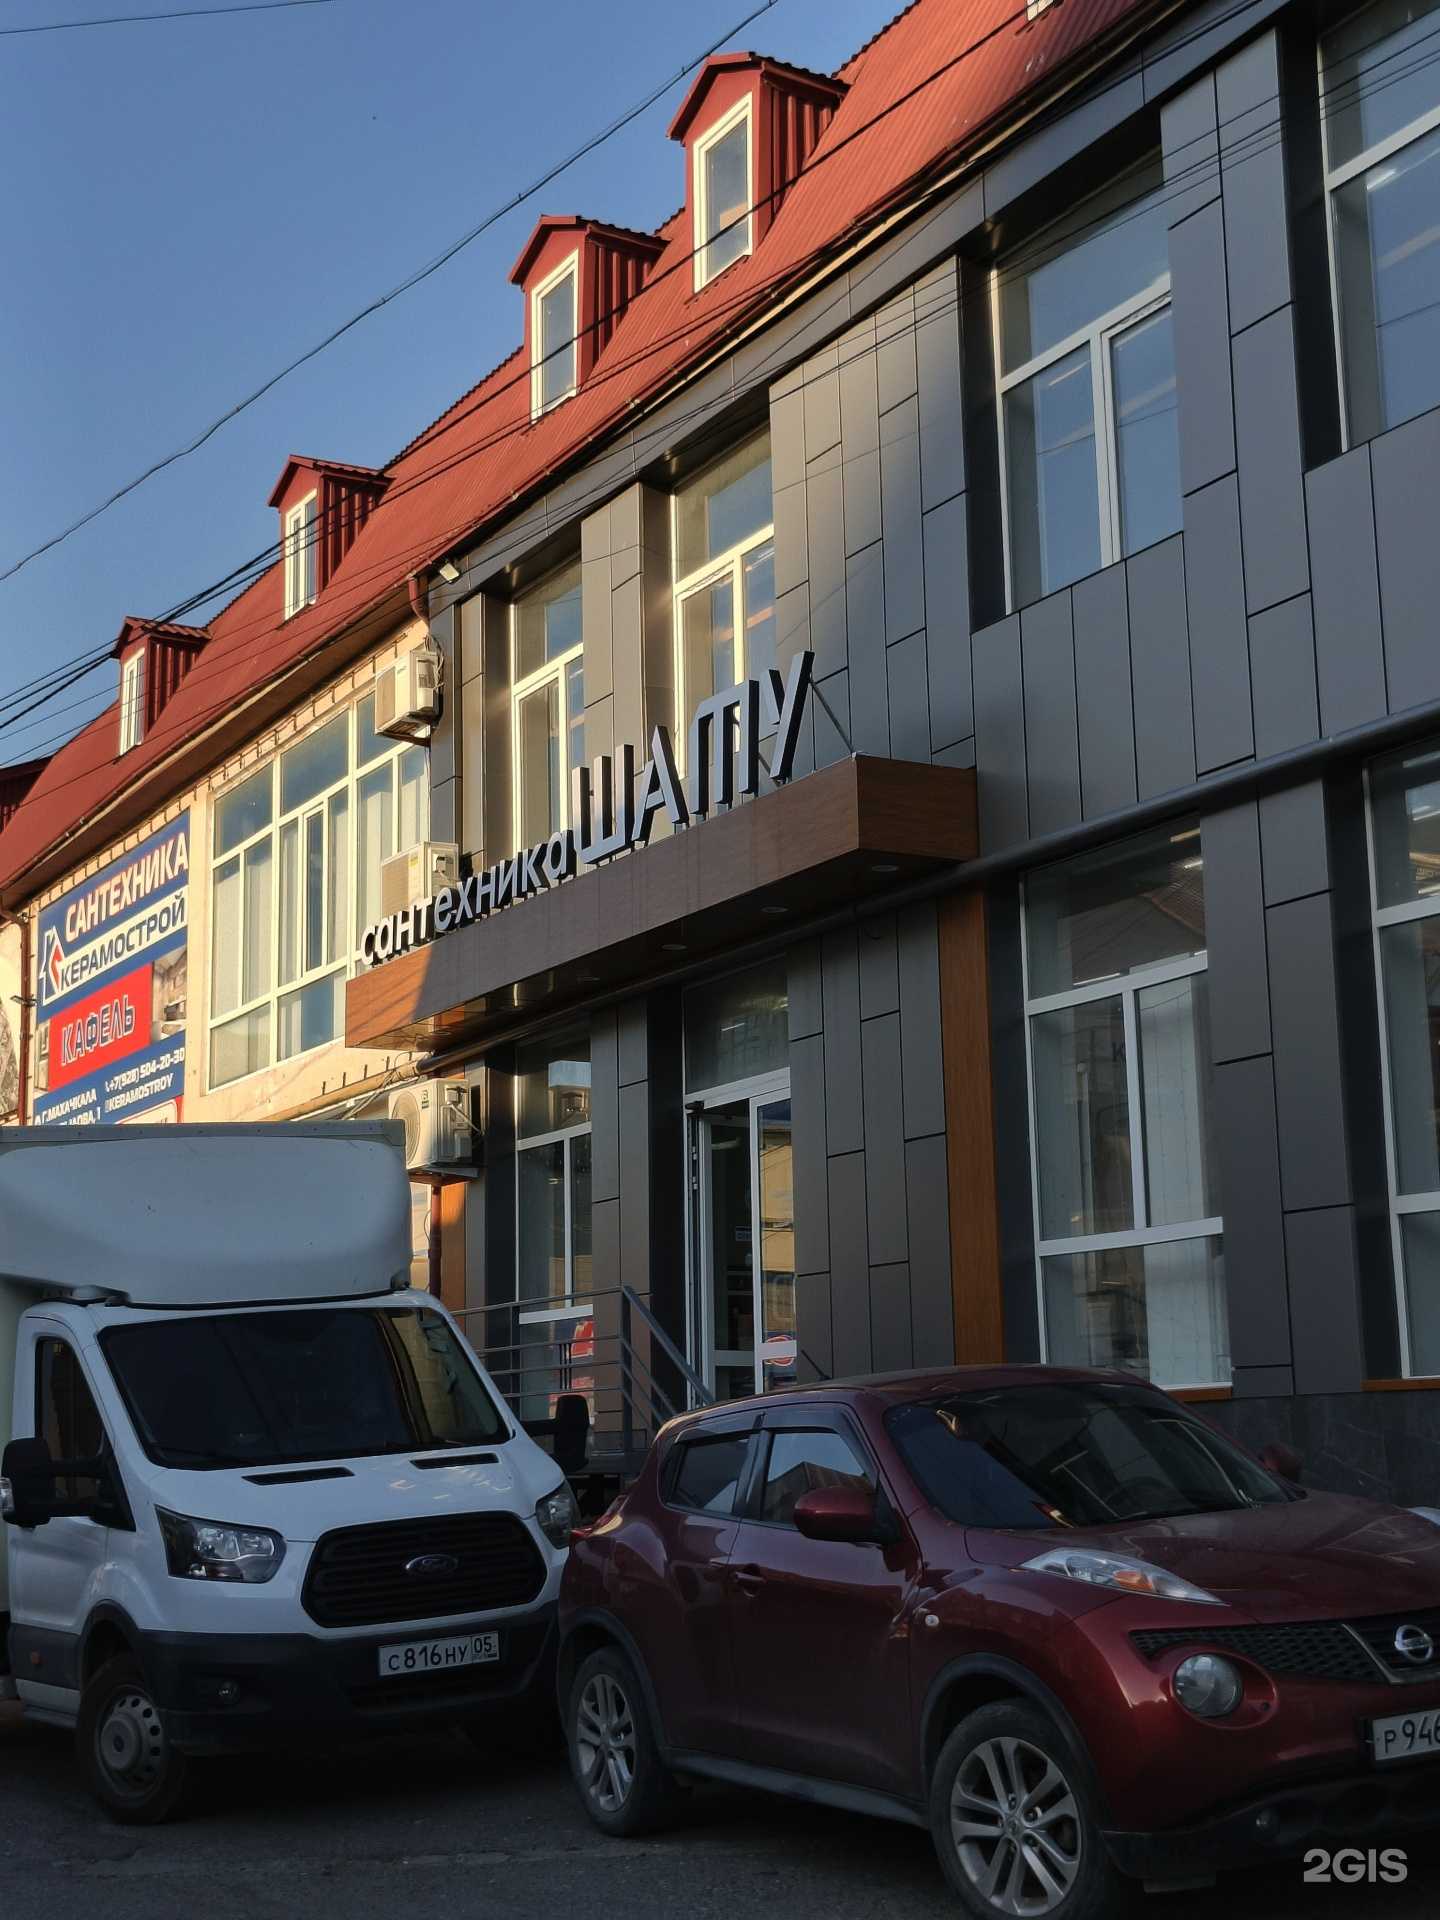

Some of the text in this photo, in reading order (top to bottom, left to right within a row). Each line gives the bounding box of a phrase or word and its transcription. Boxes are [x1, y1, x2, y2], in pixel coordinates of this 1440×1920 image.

[64, 831, 189, 944] САНТЕХНИКА
[360, 831, 574, 966] сантехника
[60, 894, 186, 992] КЕРАМОСТРОЙ
[61, 994, 136, 1067] КАФЕЛЬ
